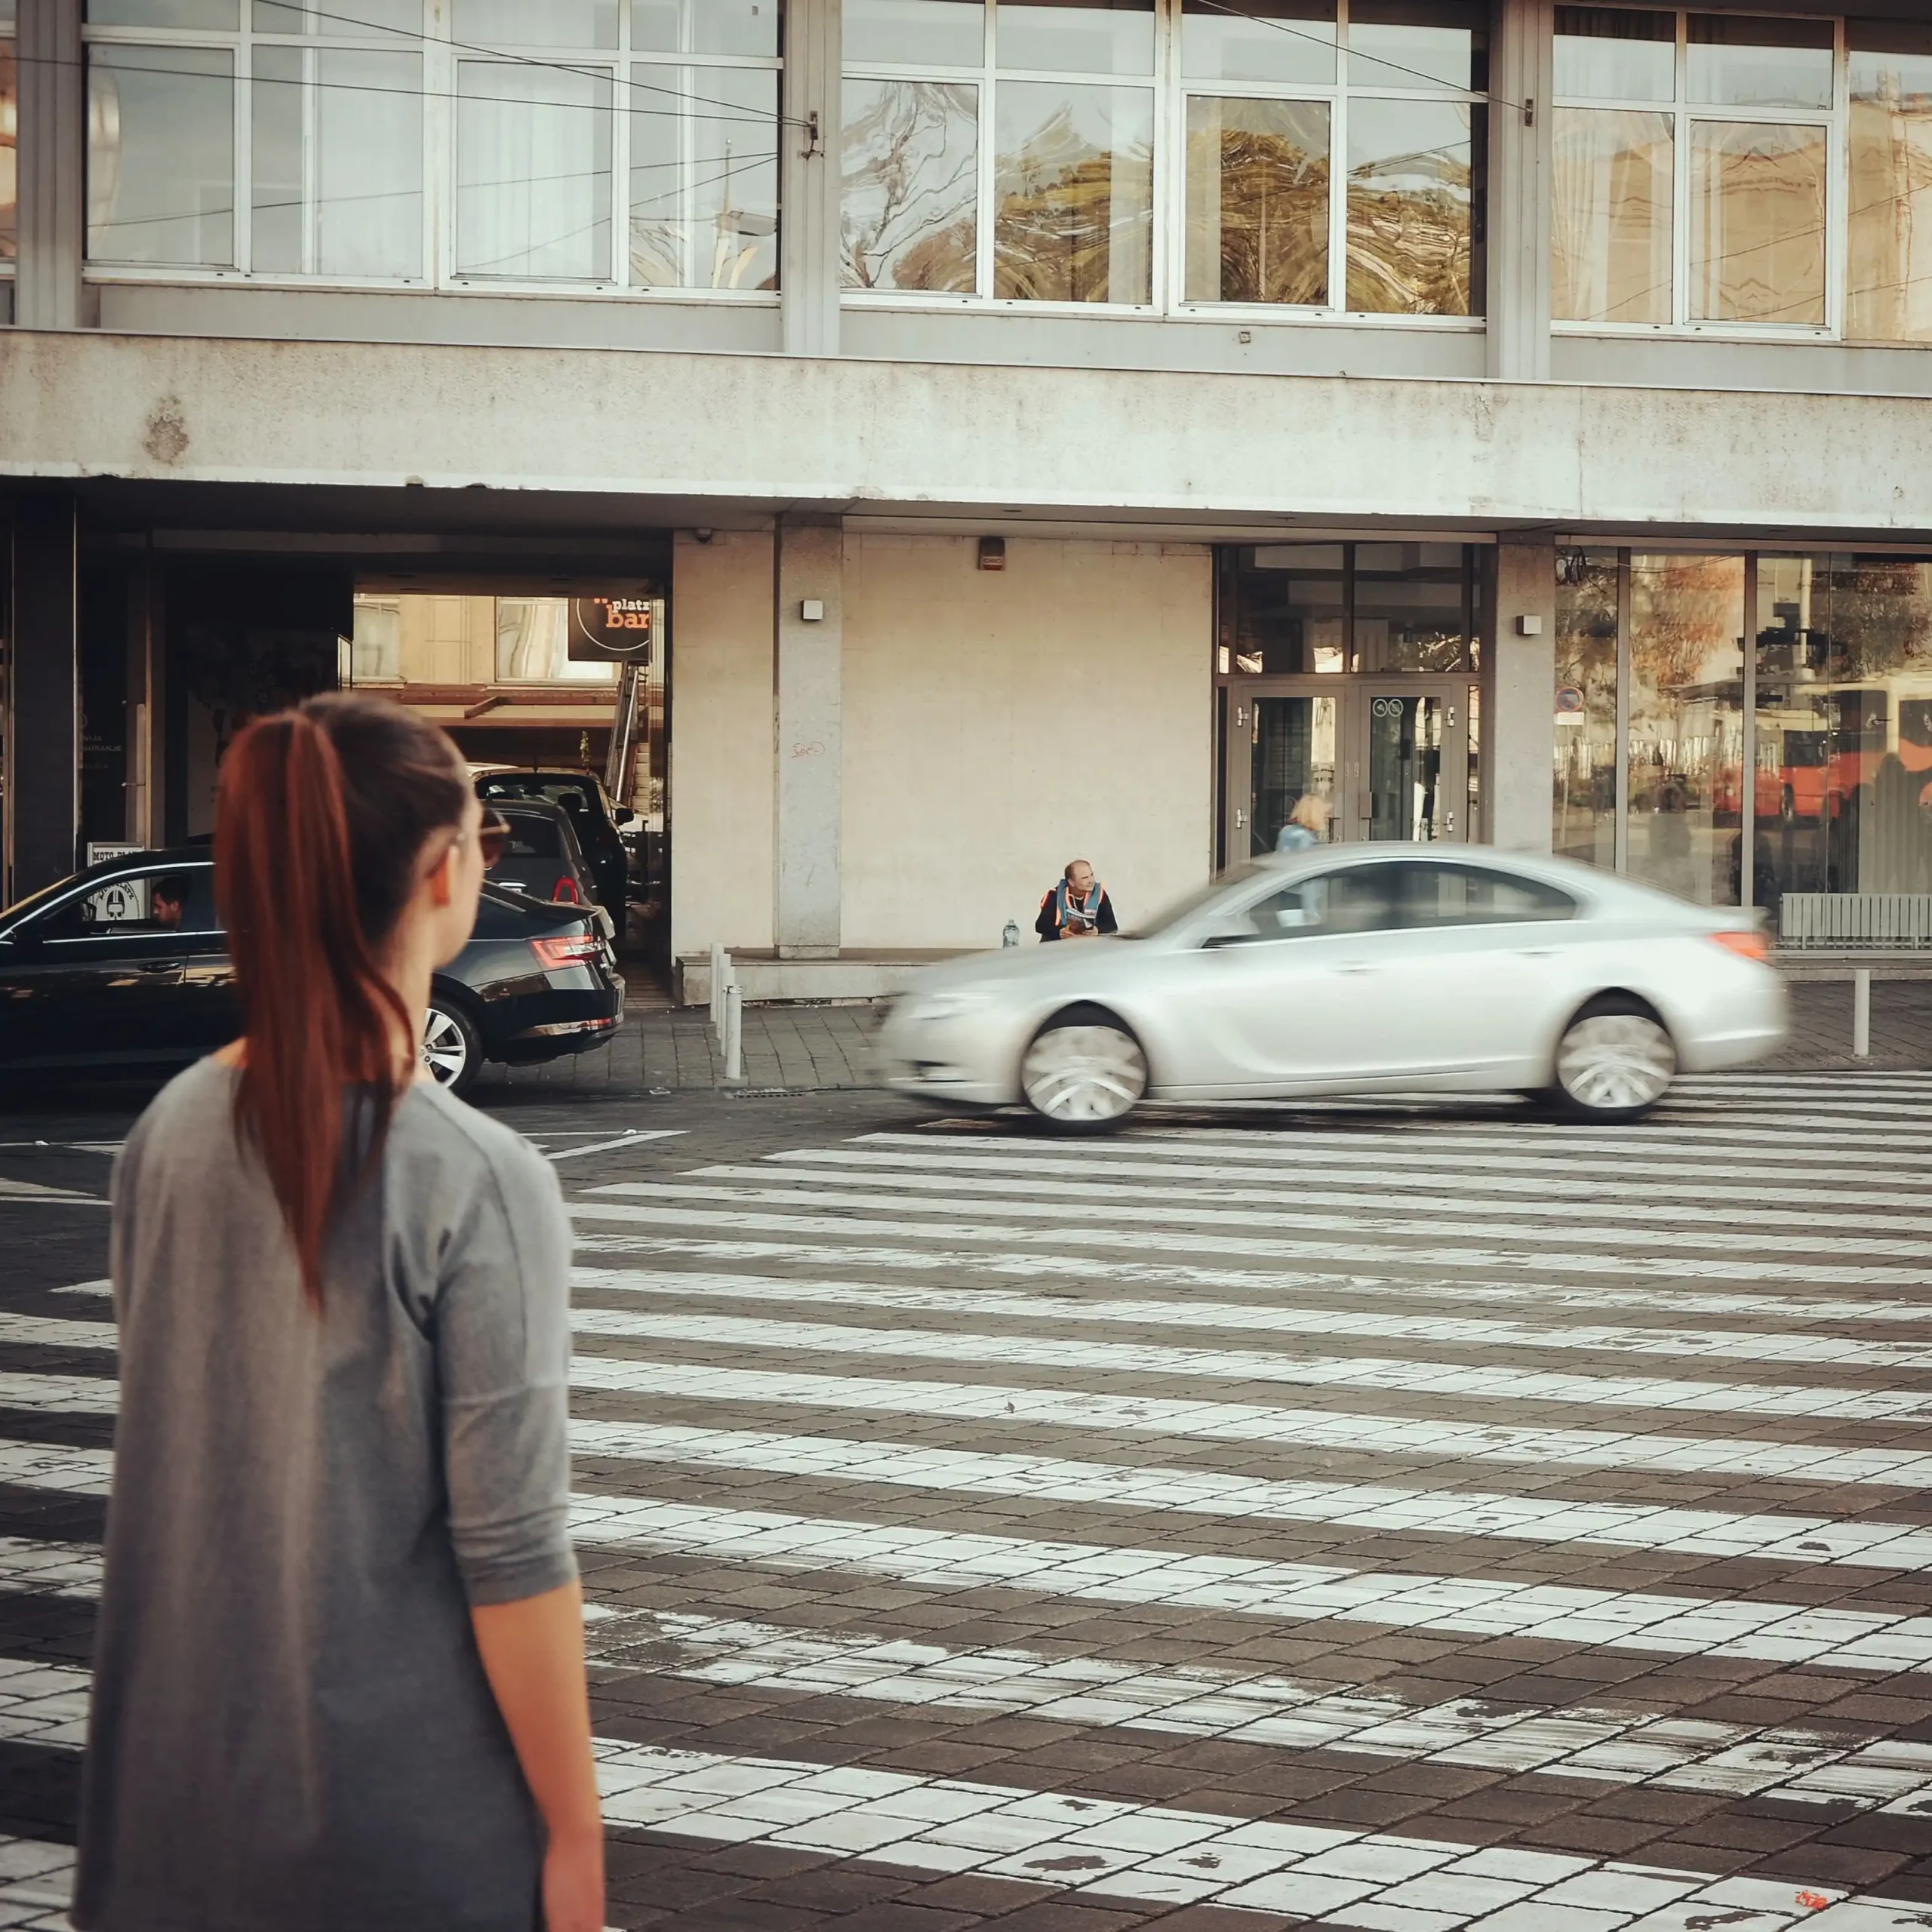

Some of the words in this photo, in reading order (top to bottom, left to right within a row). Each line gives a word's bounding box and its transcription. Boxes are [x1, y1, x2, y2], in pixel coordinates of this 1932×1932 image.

[612, 598, 650, 613] platz
[606, 605, 650, 629] bar
[94, 851, 114, 861] MOTO
